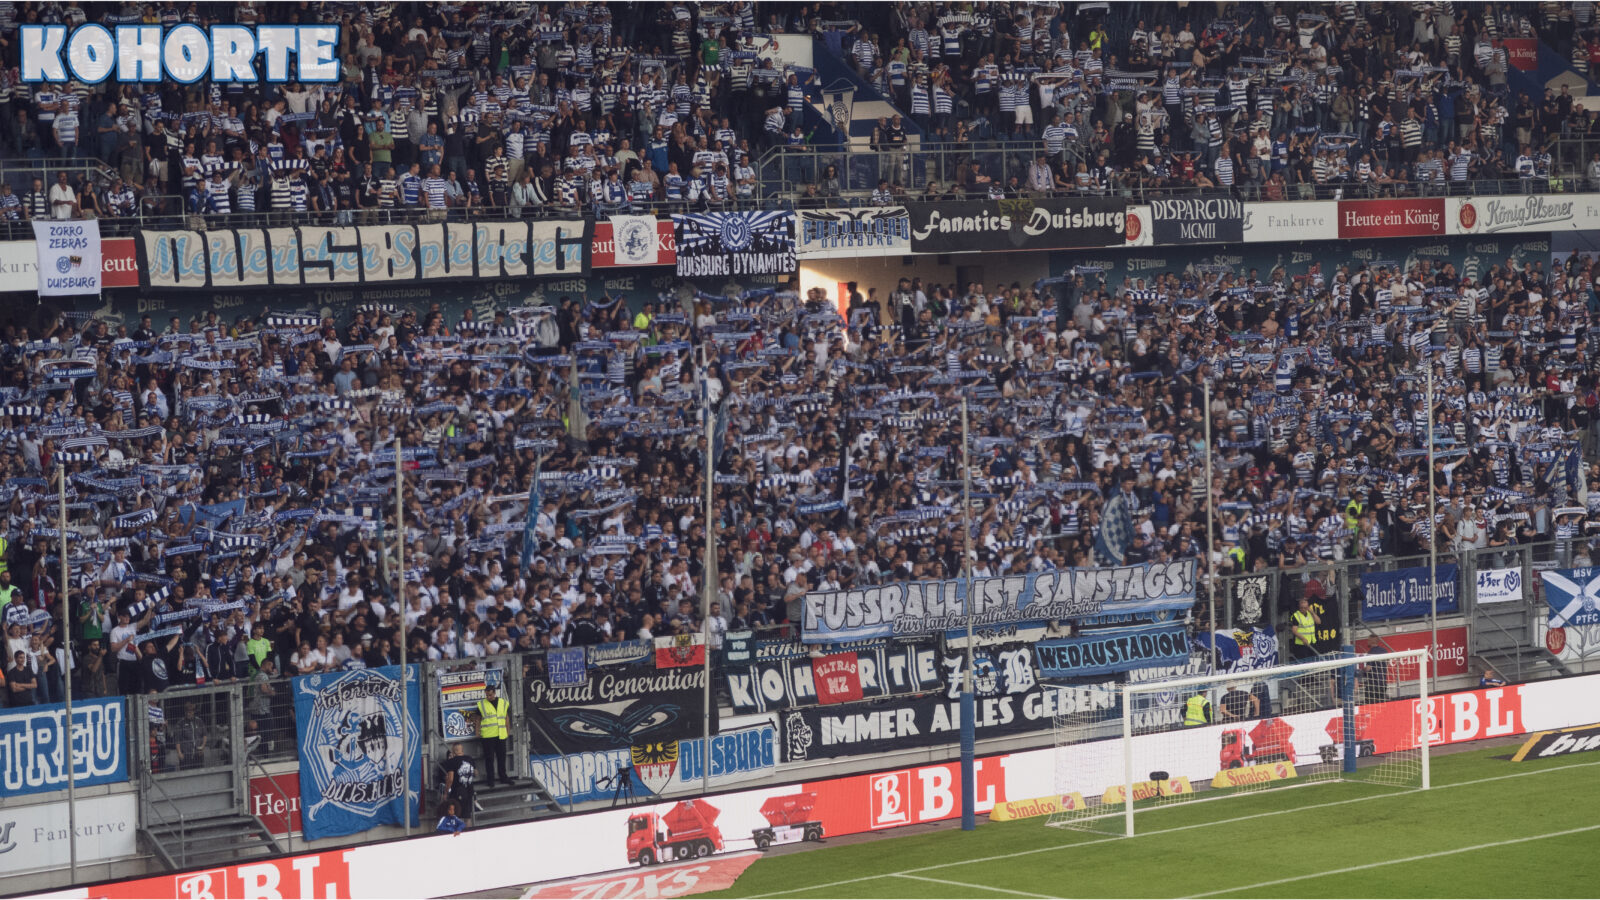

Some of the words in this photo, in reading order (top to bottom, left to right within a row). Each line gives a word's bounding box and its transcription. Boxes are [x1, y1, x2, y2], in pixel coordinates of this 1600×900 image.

[1153, 199, 1244, 221] DISPARGUM
[1344, 209, 1384, 228] Heute
[1387, 208, 1402, 225] ein
[1404, 205, 1441, 231] König
[1525, 195, 1574, 220] Pilsener
[50, 226, 83, 237] ZORRO
[913, 208, 1011, 240] Fanatics
[1023, 206, 1125, 236] Duisburg
[1180, 222, 1217, 240] MCMII
[1268, 213, 1325, 228] Fankurve
[49, 237, 88, 249] ZEBRAS
[150, 229, 381, 280] Meidericher
[389, 222, 584, 279] Spielverein
[821, 233, 893, 249] DUISBURG
[100, 250, 138, 273] eut
[677, 253, 730, 276] DUISBURG
[734, 251, 798, 275] DYNAMITES
[47, 277, 96, 289] DUISBURG
[362, 288, 431, 300] WEDAUSTADION
[1573, 568, 1593, 578] MSV
[804, 580, 965, 631] FUSSBALL
[972, 575, 1027, 614] IST
[1033, 558, 1195, 606] SAMSTAGS!
[1366, 582, 1397, 608] Block
[893, 613, 921, 634] Für
[1020, 598, 1101, 622] Anstoßzeiten
[1576, 613, 1599, 625] PTFC
[1036, 629, 1189, 671] WEDAUSTADION
[1424, 642, 1465, 666] König
[548, 661, 586, 673] STADION
[728, 651, 937, 707] KOHRTE
[816, 660, 857, 675] ULTRAS
[531, 678, 595, 704] Proud
[600, 668, 705, 702] Generation
[821, 707, 919, 746] IMMER
[929, 695, 1015, 734] ALLES
[1023, 681, 1117, 721] GEBEN!
[531, 748, 631, 800] RUHRPOTT
[679, 725, 775, 783] DUISBURG
[1227, 765, 1271, 786] Sinalco
[1118, 778, 1165, 803] Snalco
[254, 791, 300, 816] Heu
[1006, 799, 1056, 819] Sinalco
